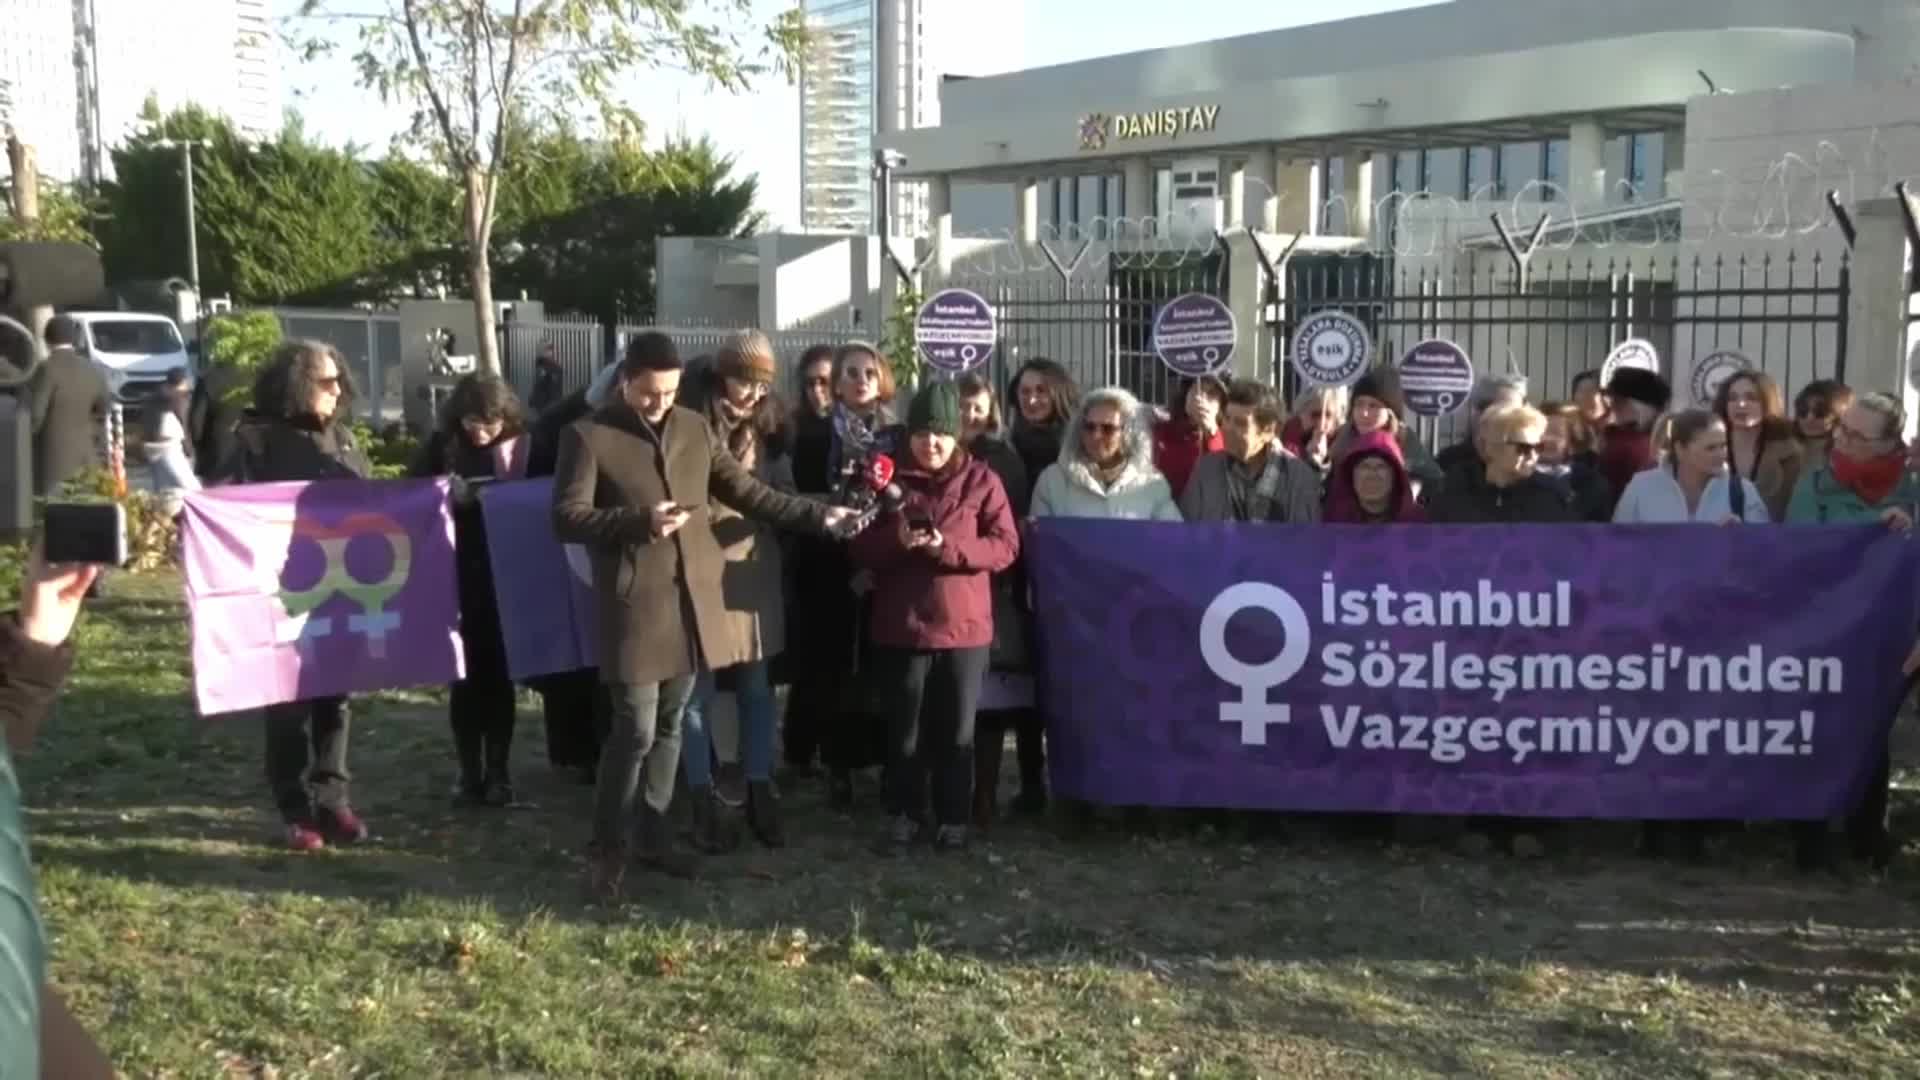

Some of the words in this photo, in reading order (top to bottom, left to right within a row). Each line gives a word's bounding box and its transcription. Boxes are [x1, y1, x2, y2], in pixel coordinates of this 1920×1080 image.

[1115, 104, 1219, 138] DANIŞTAY
[1321, 572, 1571, 626] İstanbul
[1321, 641, 1843, 701] Sözleşmesi'nden
[1320, 705, 1815, 764] Vazgeçmiyoruz!
